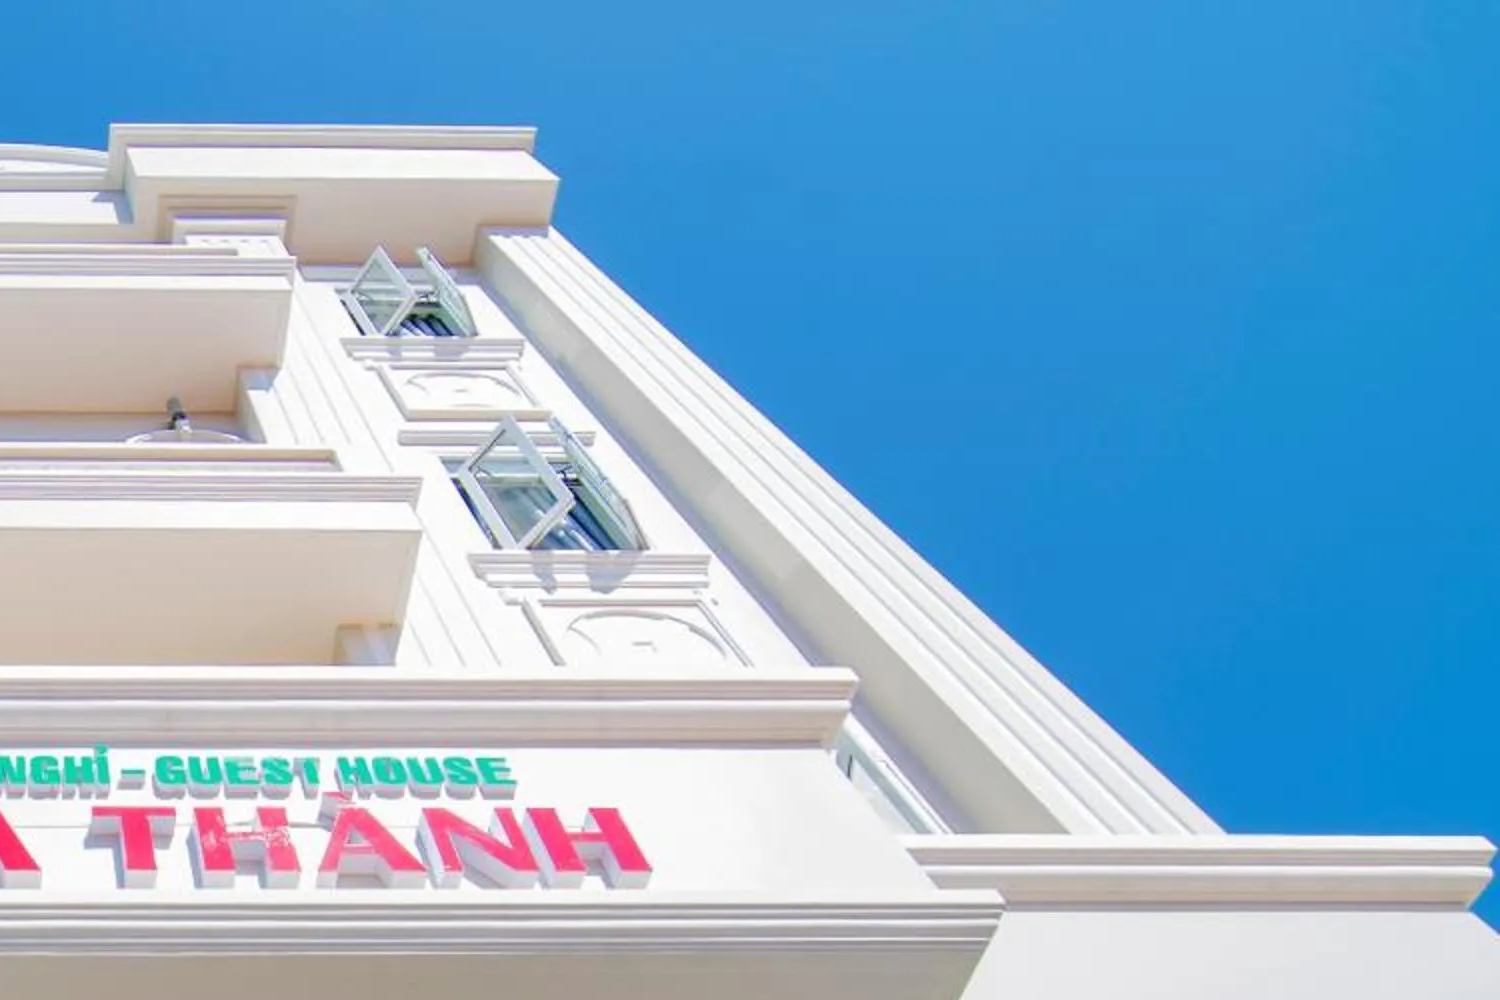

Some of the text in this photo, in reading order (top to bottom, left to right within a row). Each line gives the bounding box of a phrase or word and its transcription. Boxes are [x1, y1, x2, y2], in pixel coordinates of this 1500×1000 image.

[153, 755, 320, 793] GUEST
[335, 756, 516, 793] HOUSE
[91, 793, 653, 881] THÀNH
